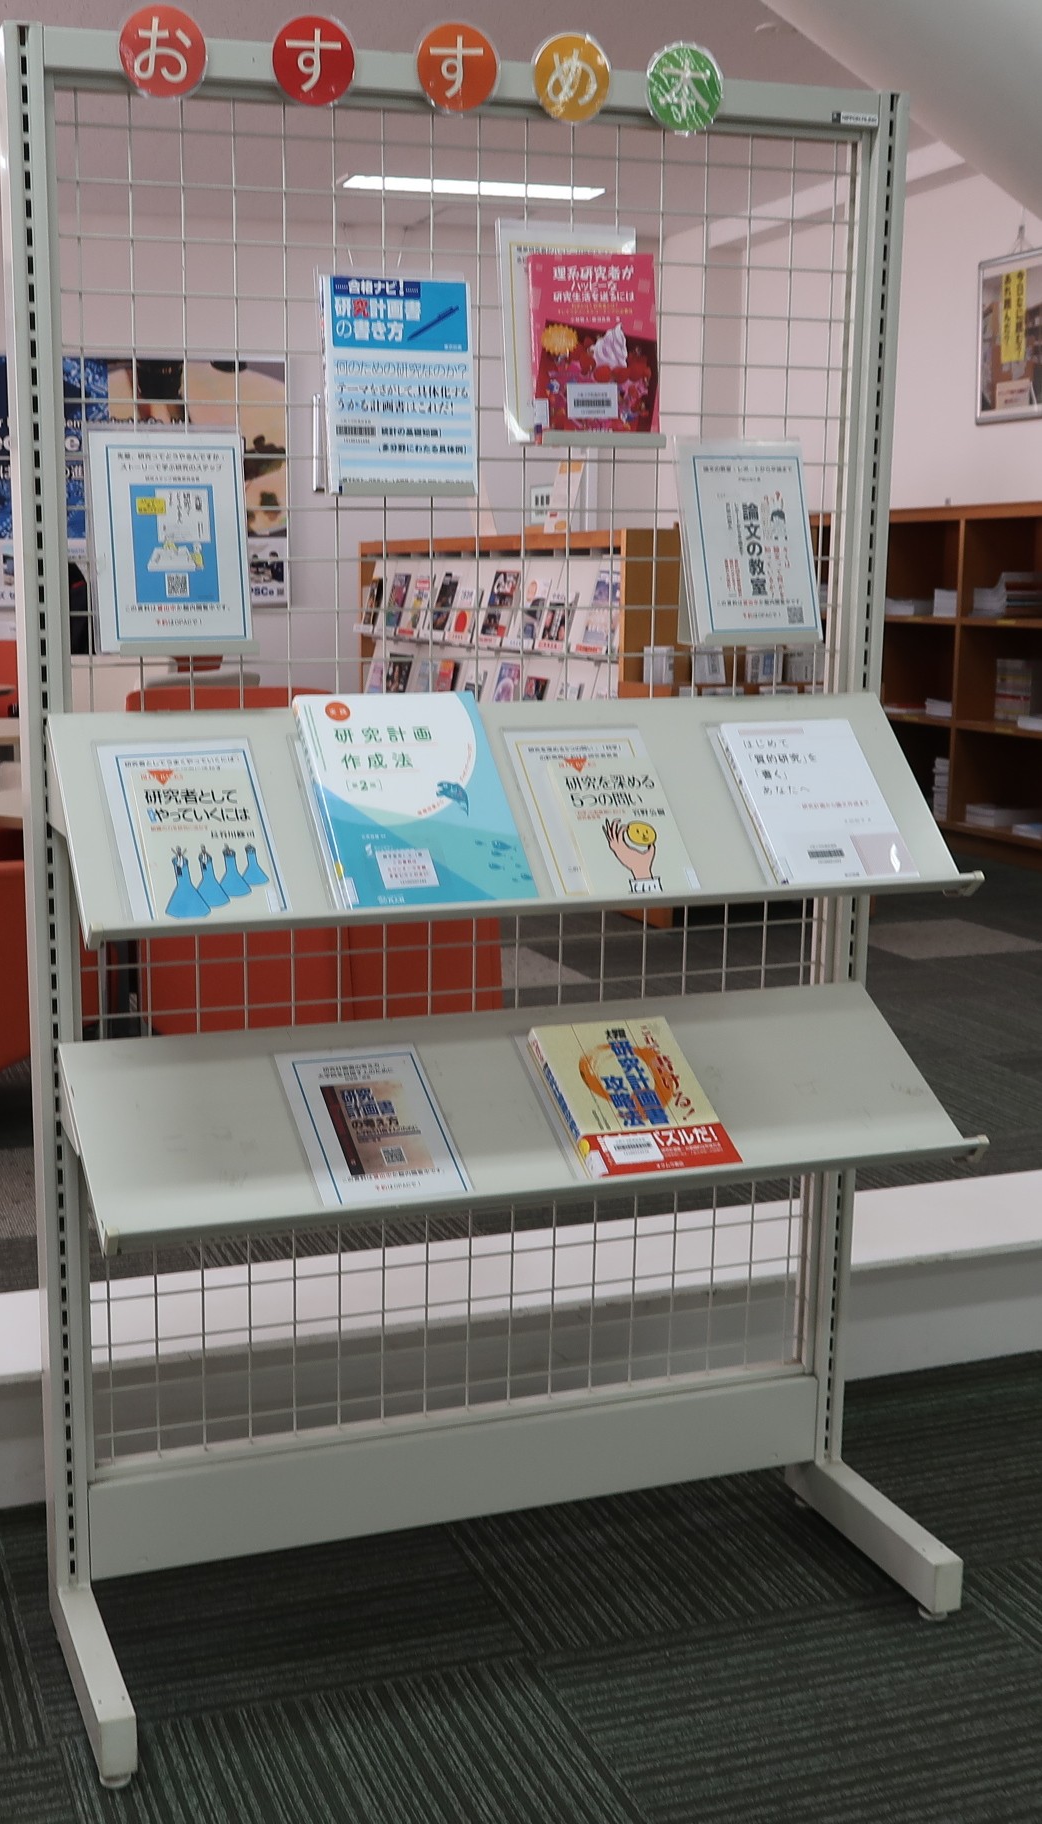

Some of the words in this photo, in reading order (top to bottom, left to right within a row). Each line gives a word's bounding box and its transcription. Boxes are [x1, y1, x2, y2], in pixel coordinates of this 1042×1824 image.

[552, 264, 635, 282] 理系研究者が
[553, 290, 635, 303] 研究生活を送るには
[334, 296, 421, 321] 研究計画書
[335, 319, 404, 341] の書き方
[742, 502, 768, 596] 論文の教室
[333, 724, 432, 743] 研究計画
[743, 738, 790, 749] はじめて
[341, 752, 414, 770] 作成法
[564, 774, 656, 791] 研究を深める
[763, 785, 810, 796] あなたへ
[144, 789, 239, 805] 研究者として
[571, 792, 643, 808] 5つの問い
[609, 1041, 670, 1125] 研究計画書
[600, 1075, 646, 1127] 攻略法
